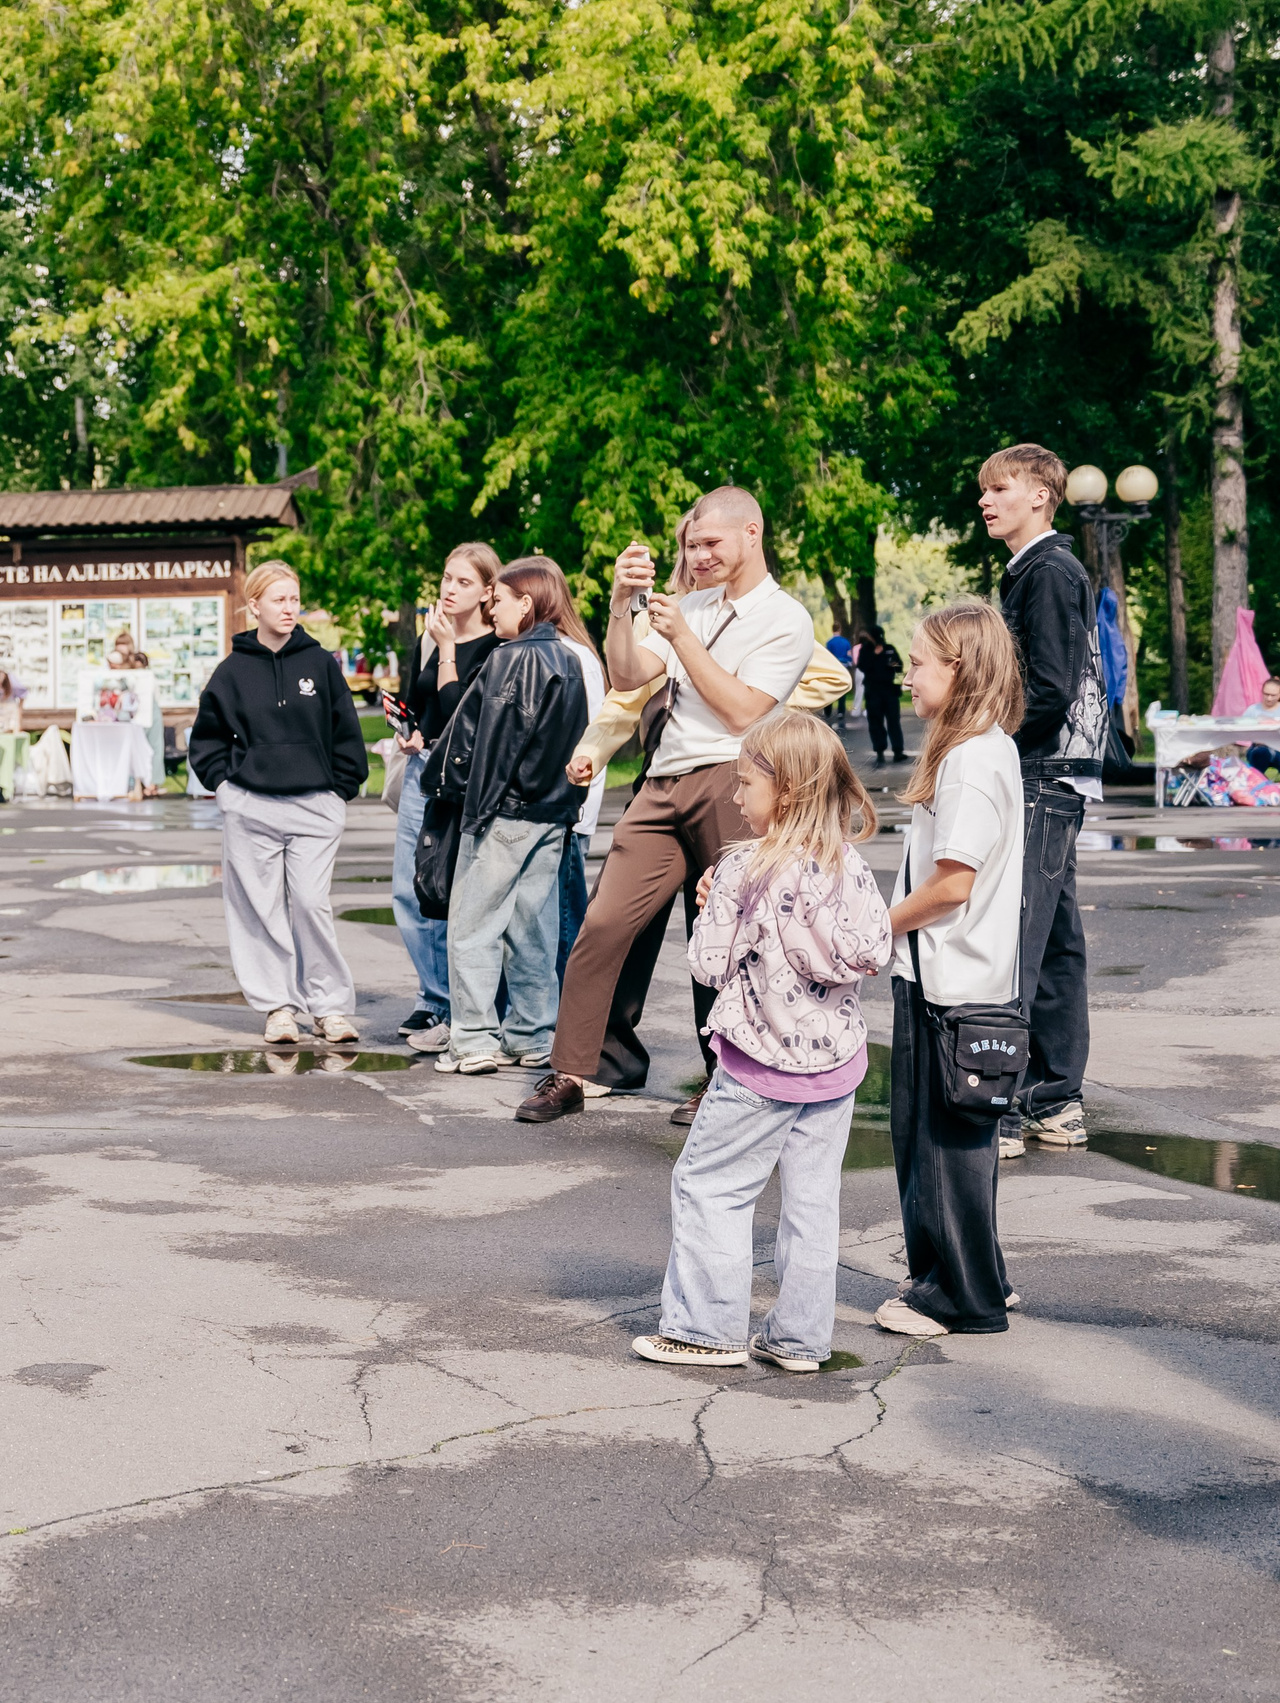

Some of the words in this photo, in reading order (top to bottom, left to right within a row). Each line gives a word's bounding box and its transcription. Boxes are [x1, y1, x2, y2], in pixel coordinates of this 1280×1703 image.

[33, 565, 64, 583] НА
[66, 562, 151, 582] АЛЛЕЯХ
[154, 560, 231, 580] ПАРКА!
[969, 1039, 1017, 1056] HELLO
